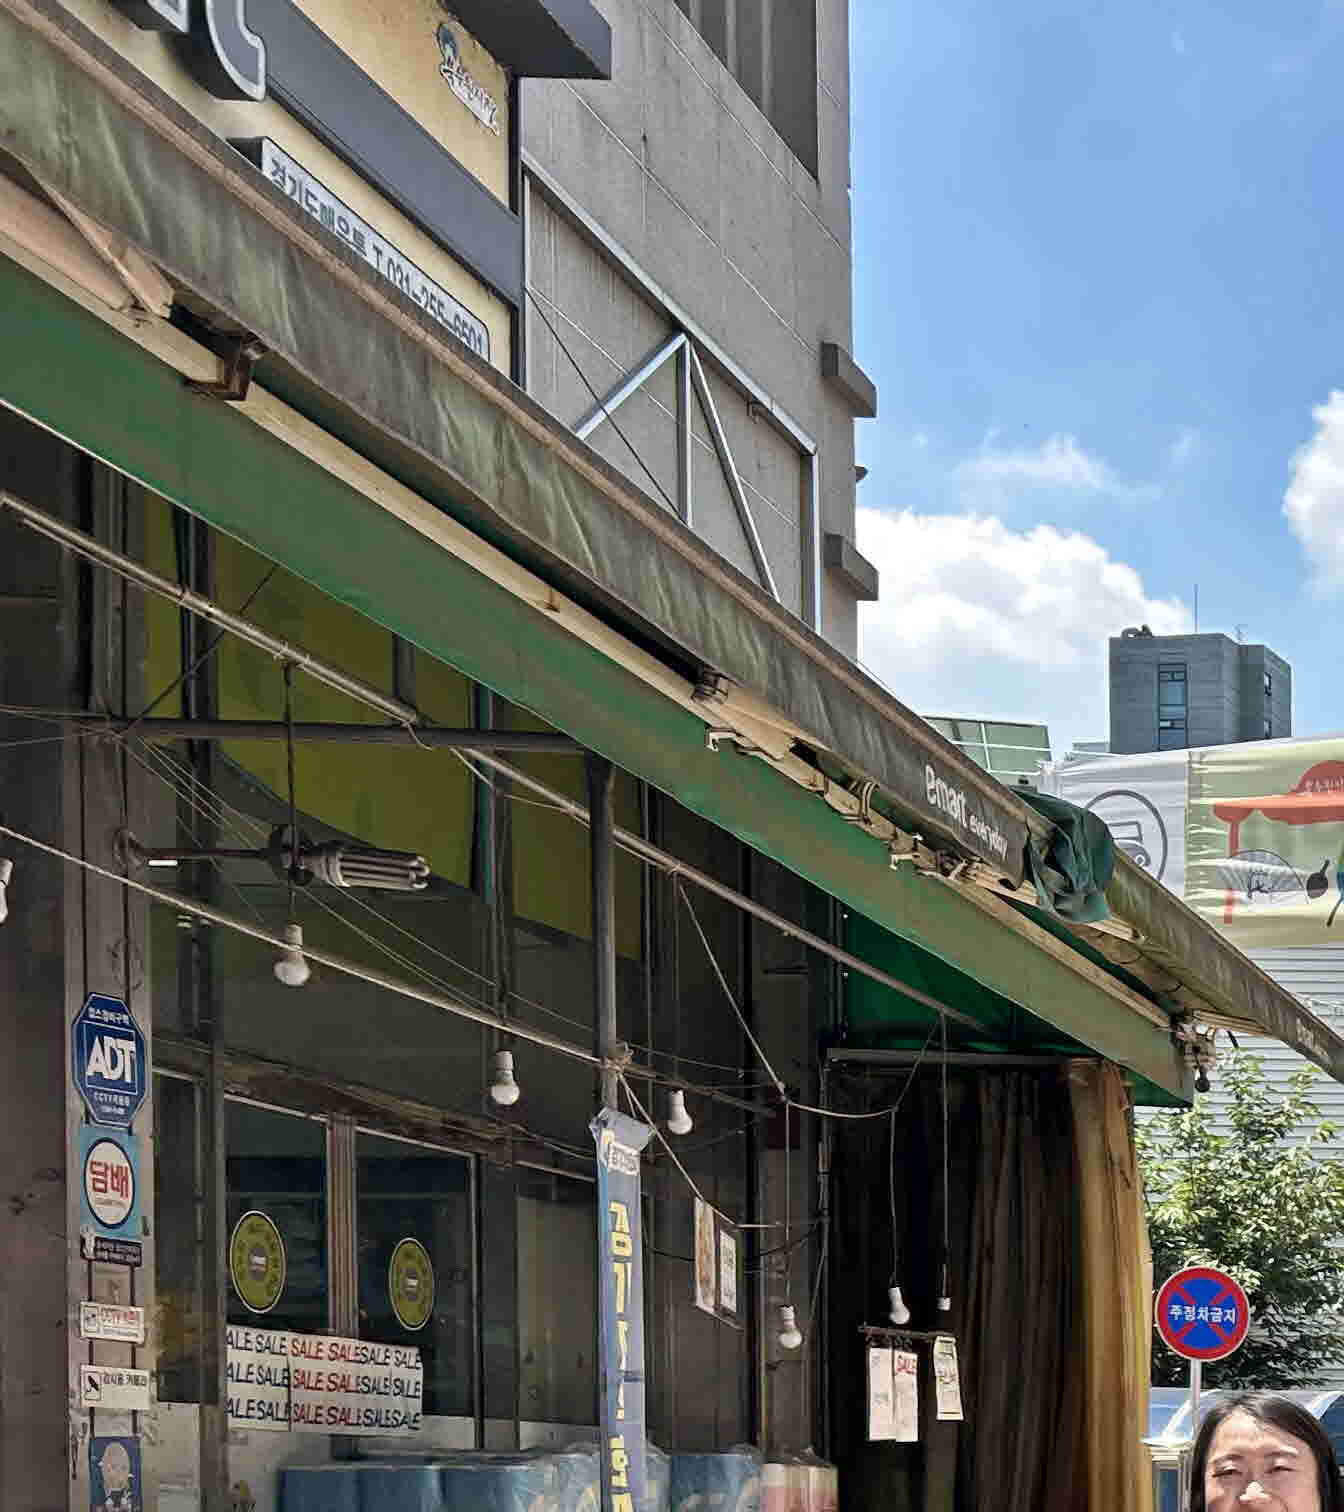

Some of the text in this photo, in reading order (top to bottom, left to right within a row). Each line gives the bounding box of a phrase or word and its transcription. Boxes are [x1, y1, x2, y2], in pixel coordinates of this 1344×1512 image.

[86, 1034, 137, 1084] ADT
[89, 1159, 129, 1200] 담배
[226, 1327, 251, 1351] ALE
[225, 1360, 254, 1384] ALE
[225, 1397, 256, 1419] ALE
